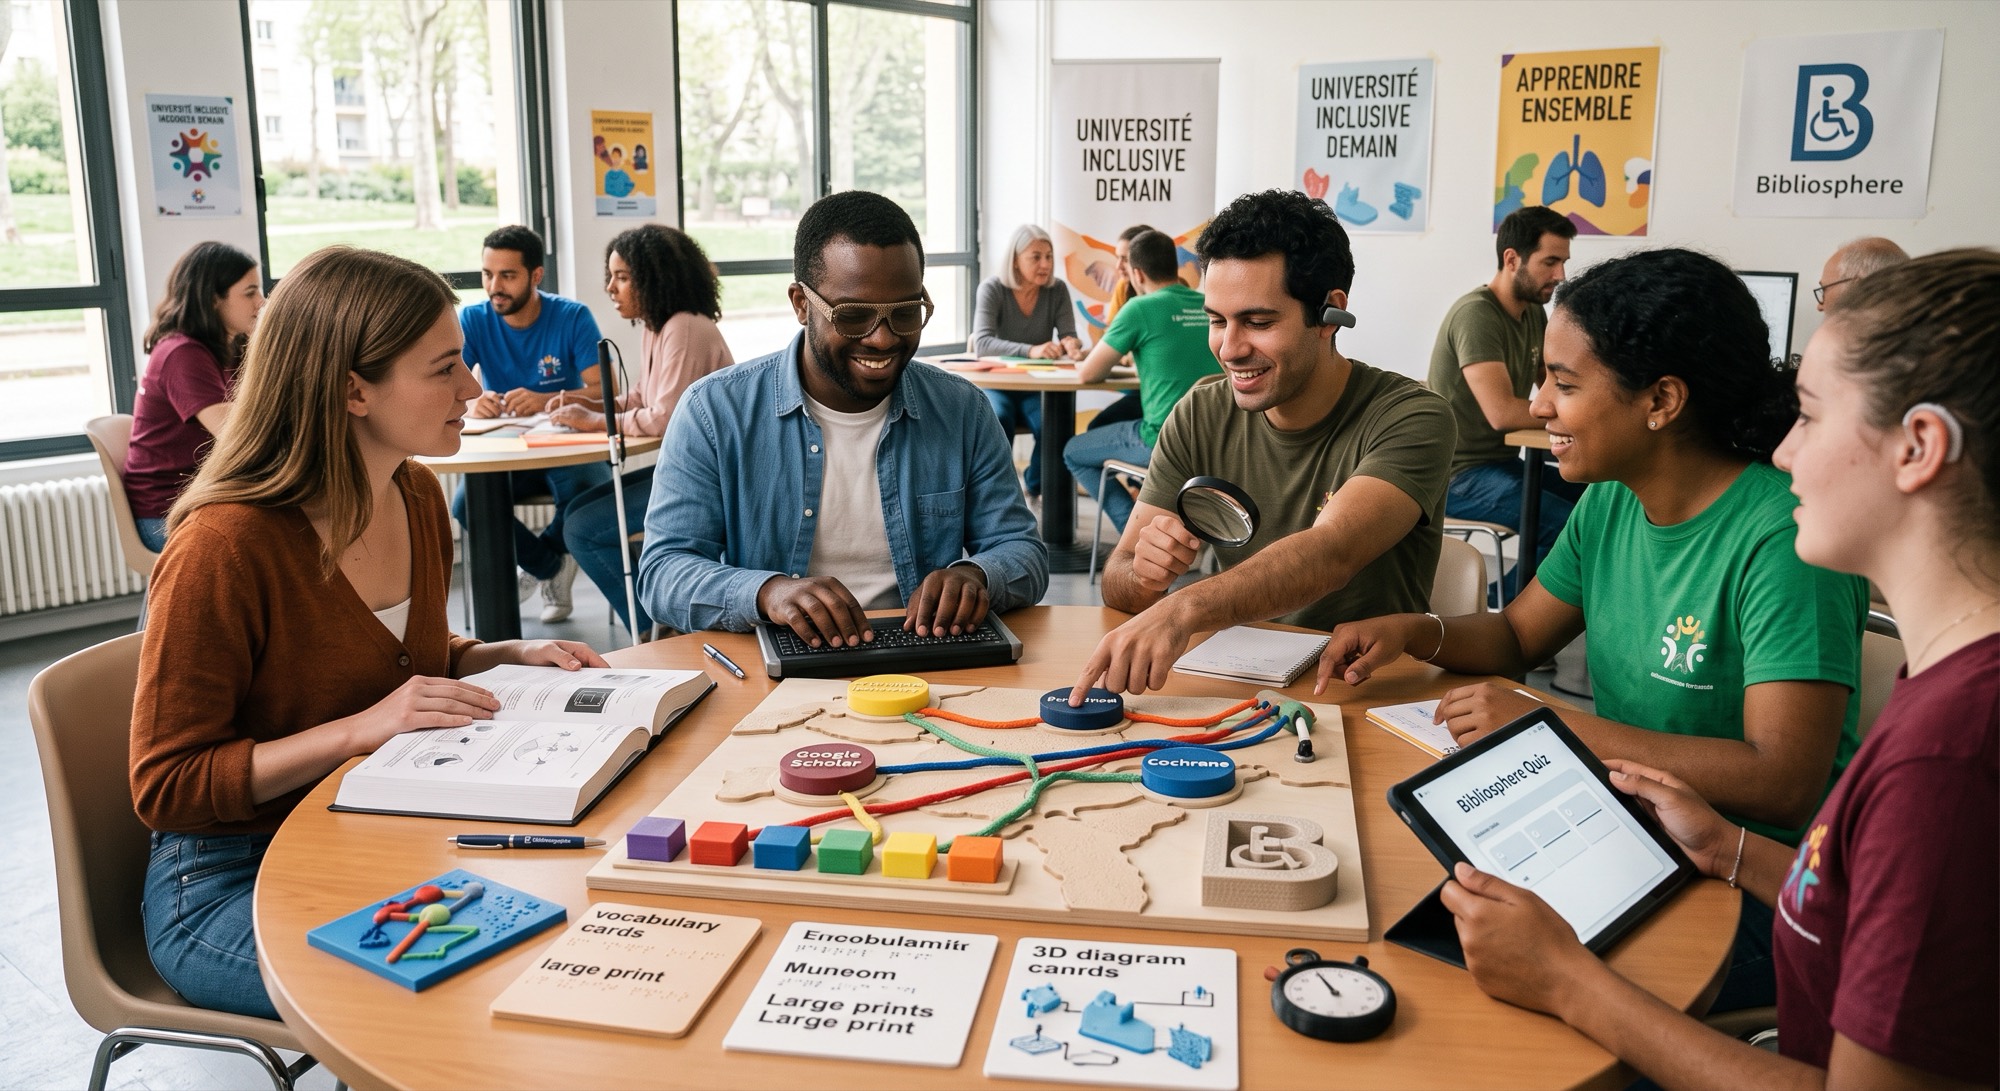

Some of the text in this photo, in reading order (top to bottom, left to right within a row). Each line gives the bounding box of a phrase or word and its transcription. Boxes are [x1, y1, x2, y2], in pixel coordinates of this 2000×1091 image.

[1311, 67, 1418, 100] UNIVERSITÉ
[1516, 62, 1642, 92] APPRENDRE
[1316, 104, 1411, 129] INCLUSIVE
[1522, 95, 1633, 123] ENSEMBLE
[1077, 112, 1192, 142] UNIVERSITÉ
[1327, 134, 1397, 158] DEMAIN
[1083, 148, 1186, 172] INCLUSIVE
[1096, 178, 1171, 202] DEMAIN
[1756, 174, 1903, 199] Bibliosphere
[790, 759, 862, 767] Scholar
[796, 750, 861, 760] Google
[1147, 758, 1230, 769] Cochrane
[1456, 752, 1551, 813] Bibliosphere Quiz
[580, 922, 645, 939] cards
[596, 910, 721, 934] vocabulary
[1032, 945, 1187, 966] 3D diagram
[540, 957, 666, 984] large print
[783, 961, 897, 980] Muneom
[1028, 964, 1119, 978] canrds
[766, 993, 935, 1019] Large prints
[758, 1010, 916, 1035] Large print
